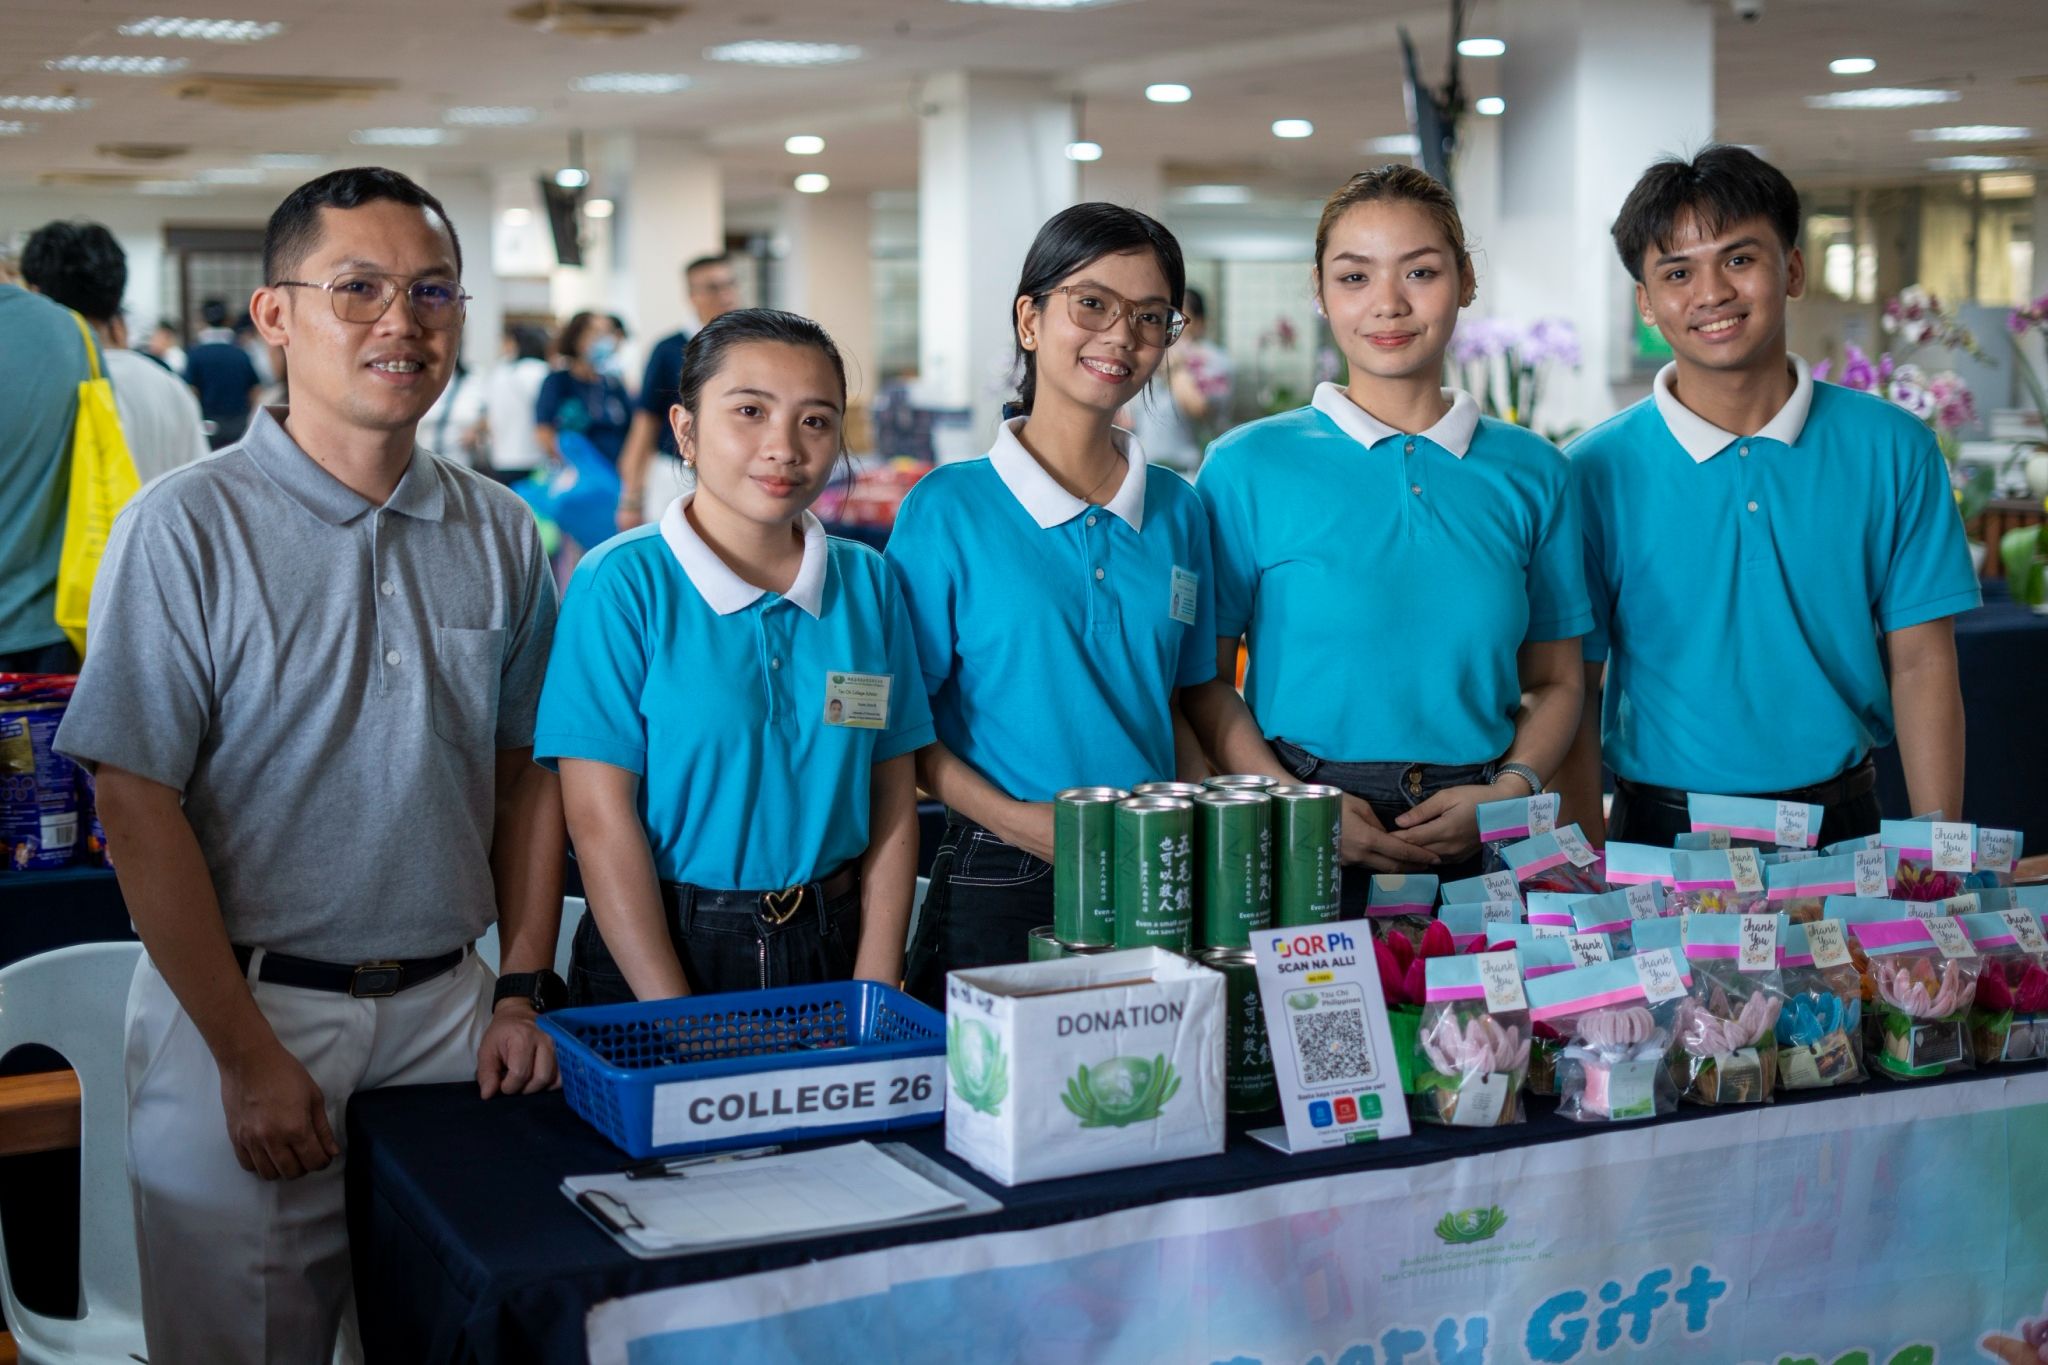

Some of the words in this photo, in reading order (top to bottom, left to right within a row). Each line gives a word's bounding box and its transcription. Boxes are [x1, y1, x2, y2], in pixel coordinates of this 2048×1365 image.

[1530, 800, 1553, 812] Thank
[1779, 804, 1807, 818] Thank
[1535, 812, 1549, 826] You
[1784, 817, 1803, 832] You
[1934, 827, 1969, 841] Thank
[1982, 830, 2014, 843] Thank
[1730, 849, 1754, 863] Thank
[1940, 840, 1964, 857] You
[1986, 843, 2007, 858] You
[1856, 854, 1883, 868] Thank
[1159, 836, 1175, 912] 也可以救人
[1736, 862, 1753, 878] You
[1862, 866, 1880, 882] You
[1484, 876, 1512, 890] Thank
[1484, 905, 1511, 919] Thank
[1908, 904, 1936, 918] Thank
[1135, 919, 1152, 927] Even
[1744, 917, 1775, 932] Thank
[2004, 913, 2033, 925] Thank
[1808, 923, 1838, 936] Thank
[2015, 924, 2035, 939] You
[1293, 935, 1327, 956] QR
[1327, 932, 1354, 952] Ph
[1571, 937, 1603, 952] Thank
[1748, 932, 1769, 950] You
[1817, 935, 1837, 952] You
[1278, 961, 1309, 974] SCAN
[1312, 959, 1329, 970] NA
[1332, 955, 1356, 967] ALL!
[1580, 950, 1602, 967] You
[1637, 953, 1672, 969] Thank
[1482, 959, 1515, 974] Thank
[1491, 974, 1514, 992] You
[1648, 967, 1671, 985] You
[1057, 1001, 1184, 1037] DONATION
[688, 1080, 876, 1125] COLLEGE
[888, 1073, 932, 1105] 26
[1508, 1239, 1537, 1251] Relief
[1381, 1273, 1398, 1283] Tzu
[1401, 1268, 1417, 1280] Chi
[1524, 1265, 1727, 1364] Gift
